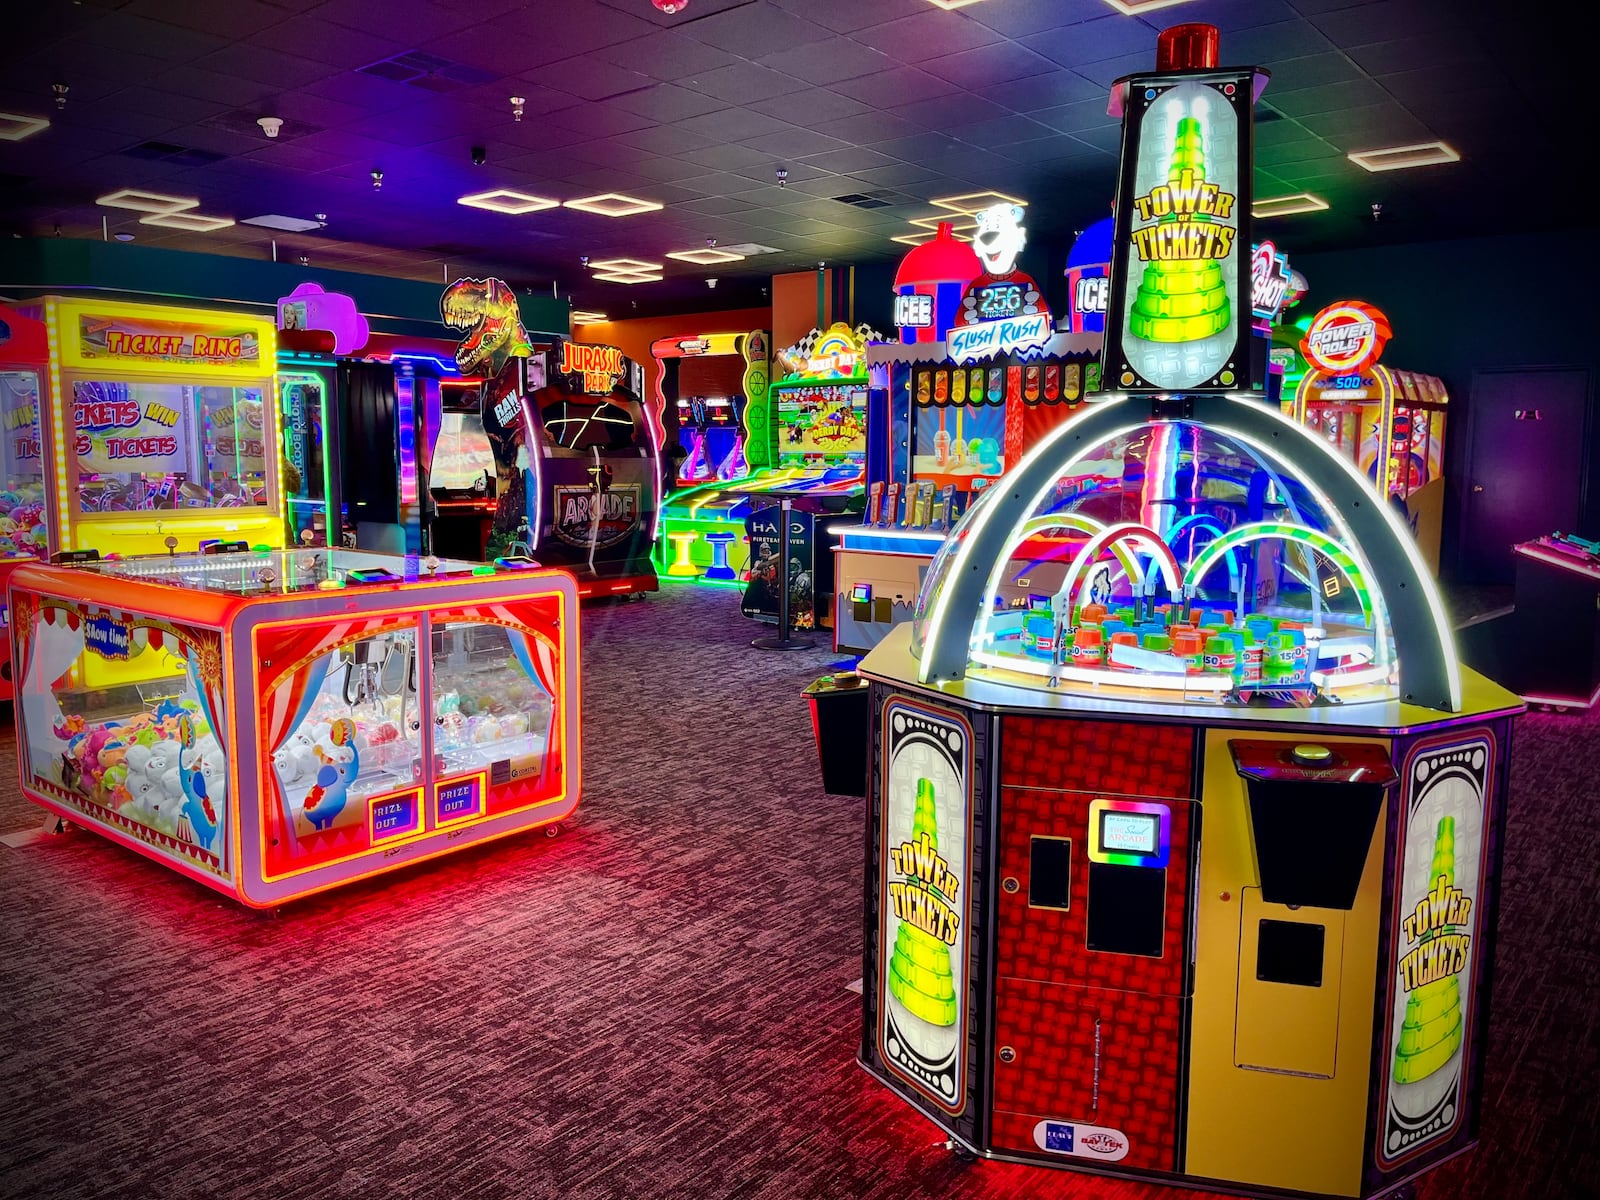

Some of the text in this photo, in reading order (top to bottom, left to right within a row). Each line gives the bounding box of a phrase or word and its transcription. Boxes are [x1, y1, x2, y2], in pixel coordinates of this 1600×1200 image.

[1134, 168, 1236, 221] TOWER
[1177, 214, 1190, 222] OF
[1131, 222, 1236, 261] TICKETS
[981, 286, 1021, 313] 256
[1076, 278, 1108, 313] ICE
[895, 296, 932, 326] ICEE
[985, 309, 1014, 318] TICKETS
[106, 331, 242, 357] TICKET RING
[953, 318, 1043, 356] SLUSH RUSH
[1310, 321, 1374, 347] POWER
[1320, 338, 1360, 355] ROLL
[561, 341, 624, 375] JURASSIC
[583, 371, 613, 393] PARK
[1336, 377, 1361, 389] 500
[75, 401, 140, 428] CKETS
[145, 402, 181, 427] WIN
[494, 388, 518, 420] RAW
[498, 403, 522, 427] THRILLS
[813, 425, 859, 438] DERBY DAY
[106, 436, 177, 460] TICKETS
[563, 493, 633, 527] ARCADE
[752, 536, 780, 544] FIRETEA
[86, 622, 127, 649] Show time
[440, 786, 470, 801] PRIZE
[444, 800, 465, 812] OUT
[376, 816, 398, 830] OUT
[1109, 833, 1148, 843] ARCADE
[889, 831, 959, 903] TOWER
[888, 881, 960, 947] TICKETS
[1403, 874, 1473, 946] TOWER
[1399, 933, 1471, 994] TICKETS
[1081, 1137, 1100, 1146] BAY
[1104, 1138, 1124, 1149] TEK
